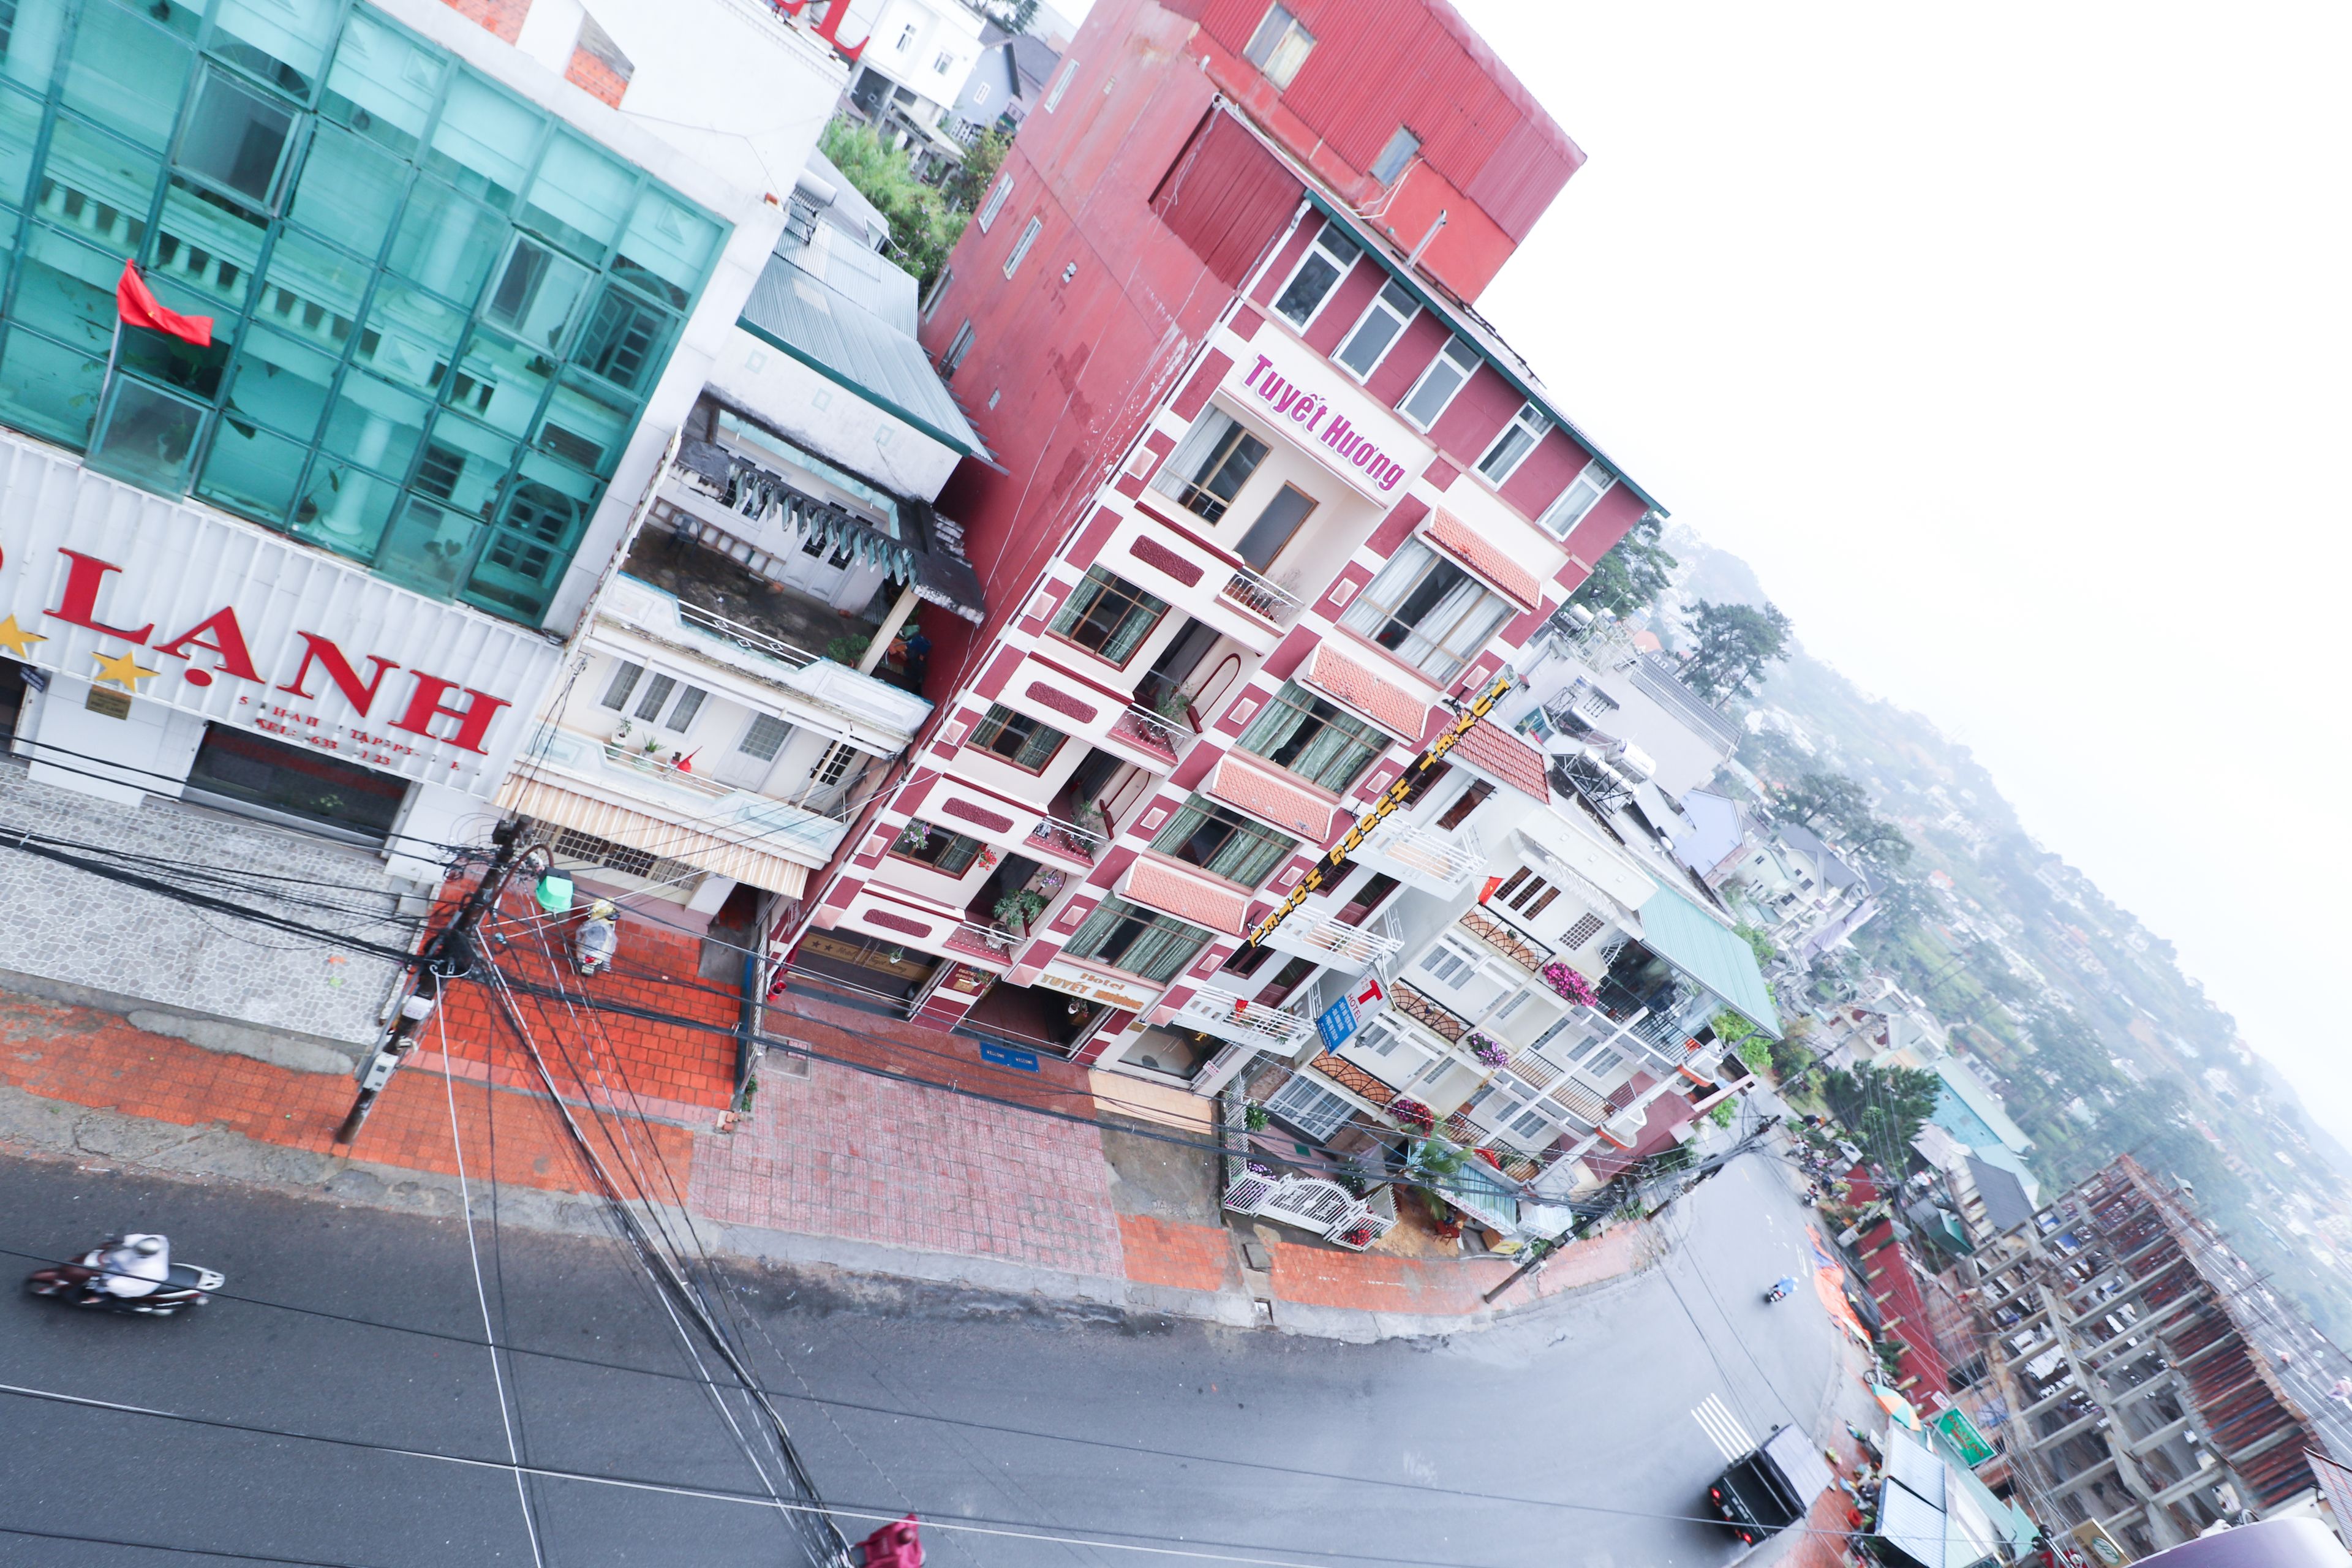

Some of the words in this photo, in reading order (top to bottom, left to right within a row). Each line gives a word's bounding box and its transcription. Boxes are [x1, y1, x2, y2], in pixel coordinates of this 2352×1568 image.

[1244, 353, 1328, 432] Tuyết
[1321, 414, 1406, 491] Hương
[43, 547, 512, 756] LẠNH
[1249, 867, 1324, 949] HOTEL
[1040, 973, 1091, 994] TUYẾT
[1079, 971, 1125, 991] Hotel
[1357, 979, 1383, 1005] T
[1347, 993, 1362, 1022] HOTEL
